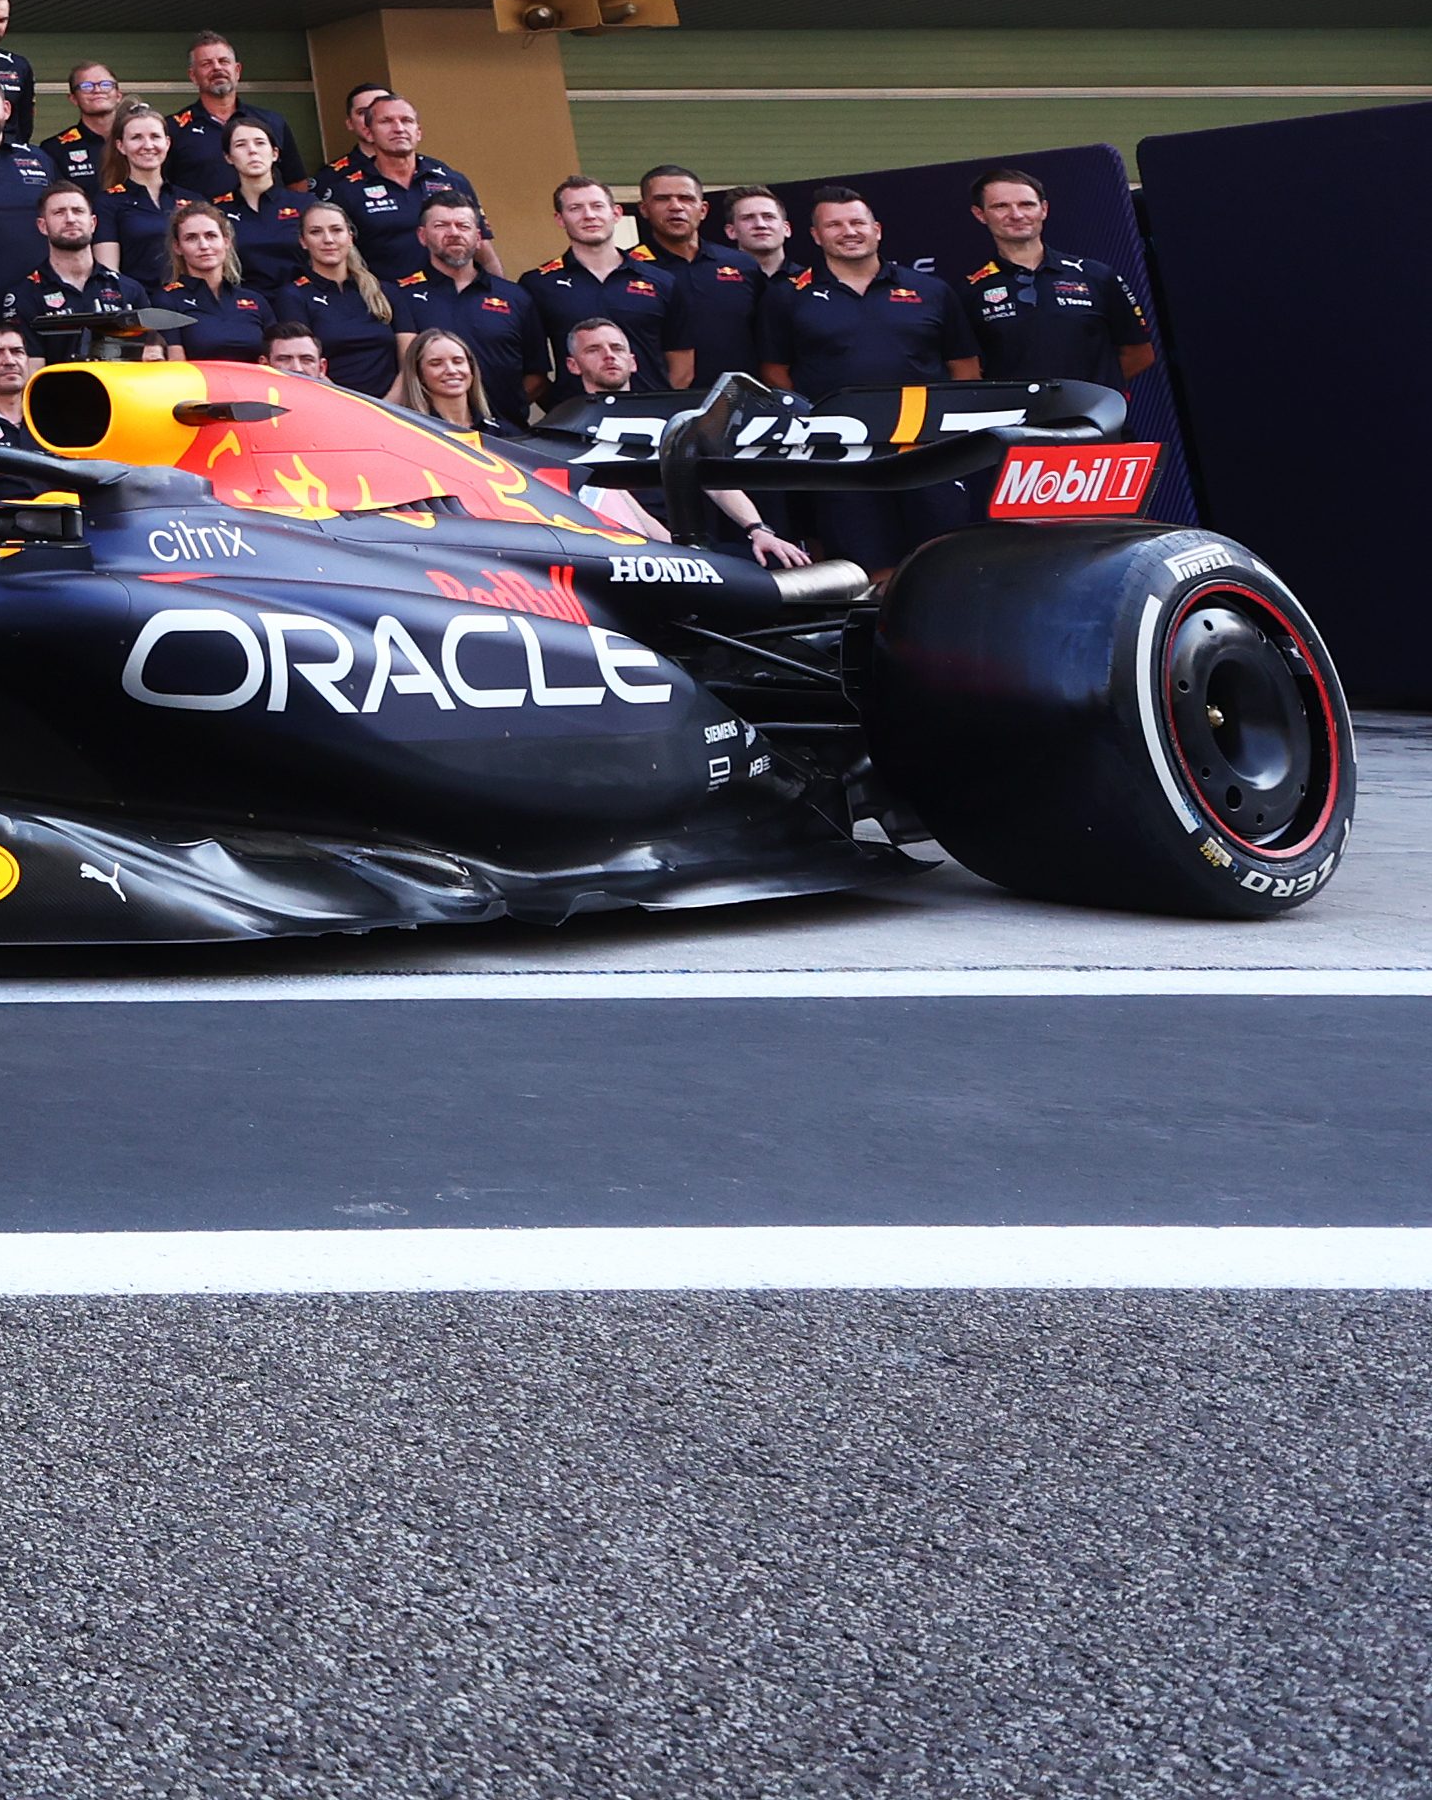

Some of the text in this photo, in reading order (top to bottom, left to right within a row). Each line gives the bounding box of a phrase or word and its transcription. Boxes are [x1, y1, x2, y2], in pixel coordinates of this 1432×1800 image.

[995, 457, 1106, 507] Mobil
[148, 520, 256, 563] citrix
[610, 556, 724, 585] HONDA
[1166, 543, 1233, 582] PIRELLI
[121, 608, 673, 715] ORACLE
[704, 720, 738, 744] SIEMENS
